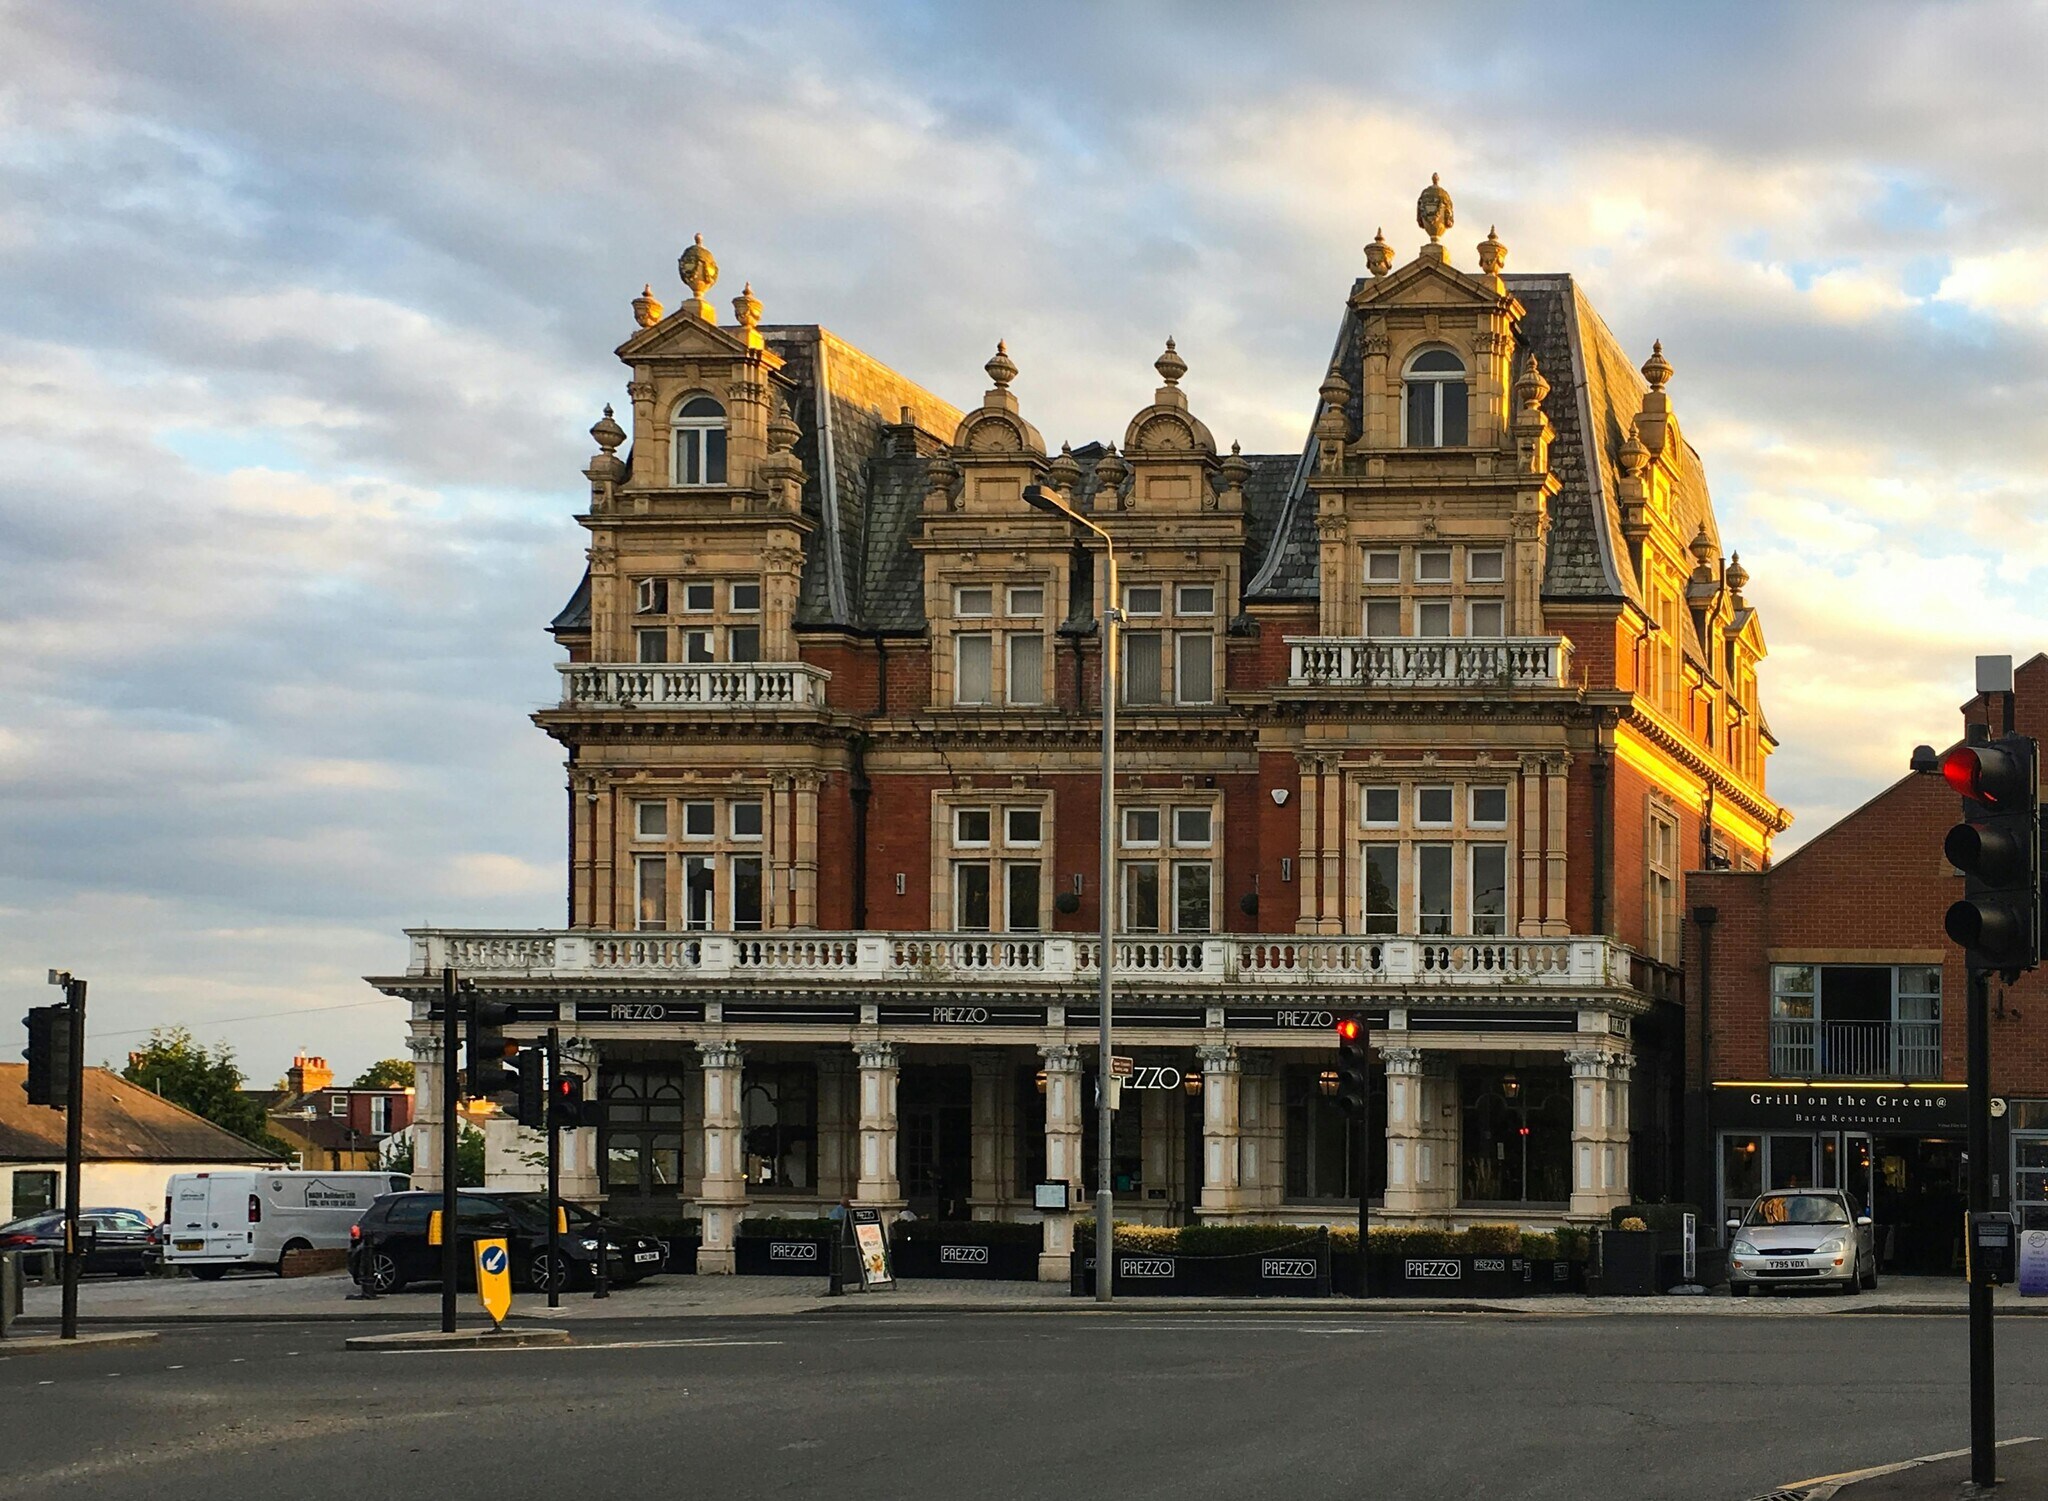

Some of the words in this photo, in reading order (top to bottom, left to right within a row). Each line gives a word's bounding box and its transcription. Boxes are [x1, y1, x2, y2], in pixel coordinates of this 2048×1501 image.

[611, 1004, 664, 1020] PREZZO
[933, 1007, 988, 1023] PREZZO
[1277, 1010, 1333, 1027] PREZZO
[1750, 1093, 1799, 1105] Grill
[1808, 1095, 1828, 1106] on
[1838, 1095, 1867, 1106] the
[1796, 1113, 1817, 1122] Bar
[1820, 1114, 1827, 1122] &
[1831, 1114, 1902, 1123] Restaurant
[773, 1245, 815, 1258] PREZZO
[943, 1248, 986, 1261] PREZZO
[1123, 1261, 1172, 1277] PREZZO
[1264, 1261, 1314, 1277] PREZZO
[1408, 1262, 1459, 1277] PREZZO
[1475, 1261, 1503, 1270] PREZZO
[1769, 1260, 1789, 1268] Y795
[1791, 1260, 1805, 1268] VDX
